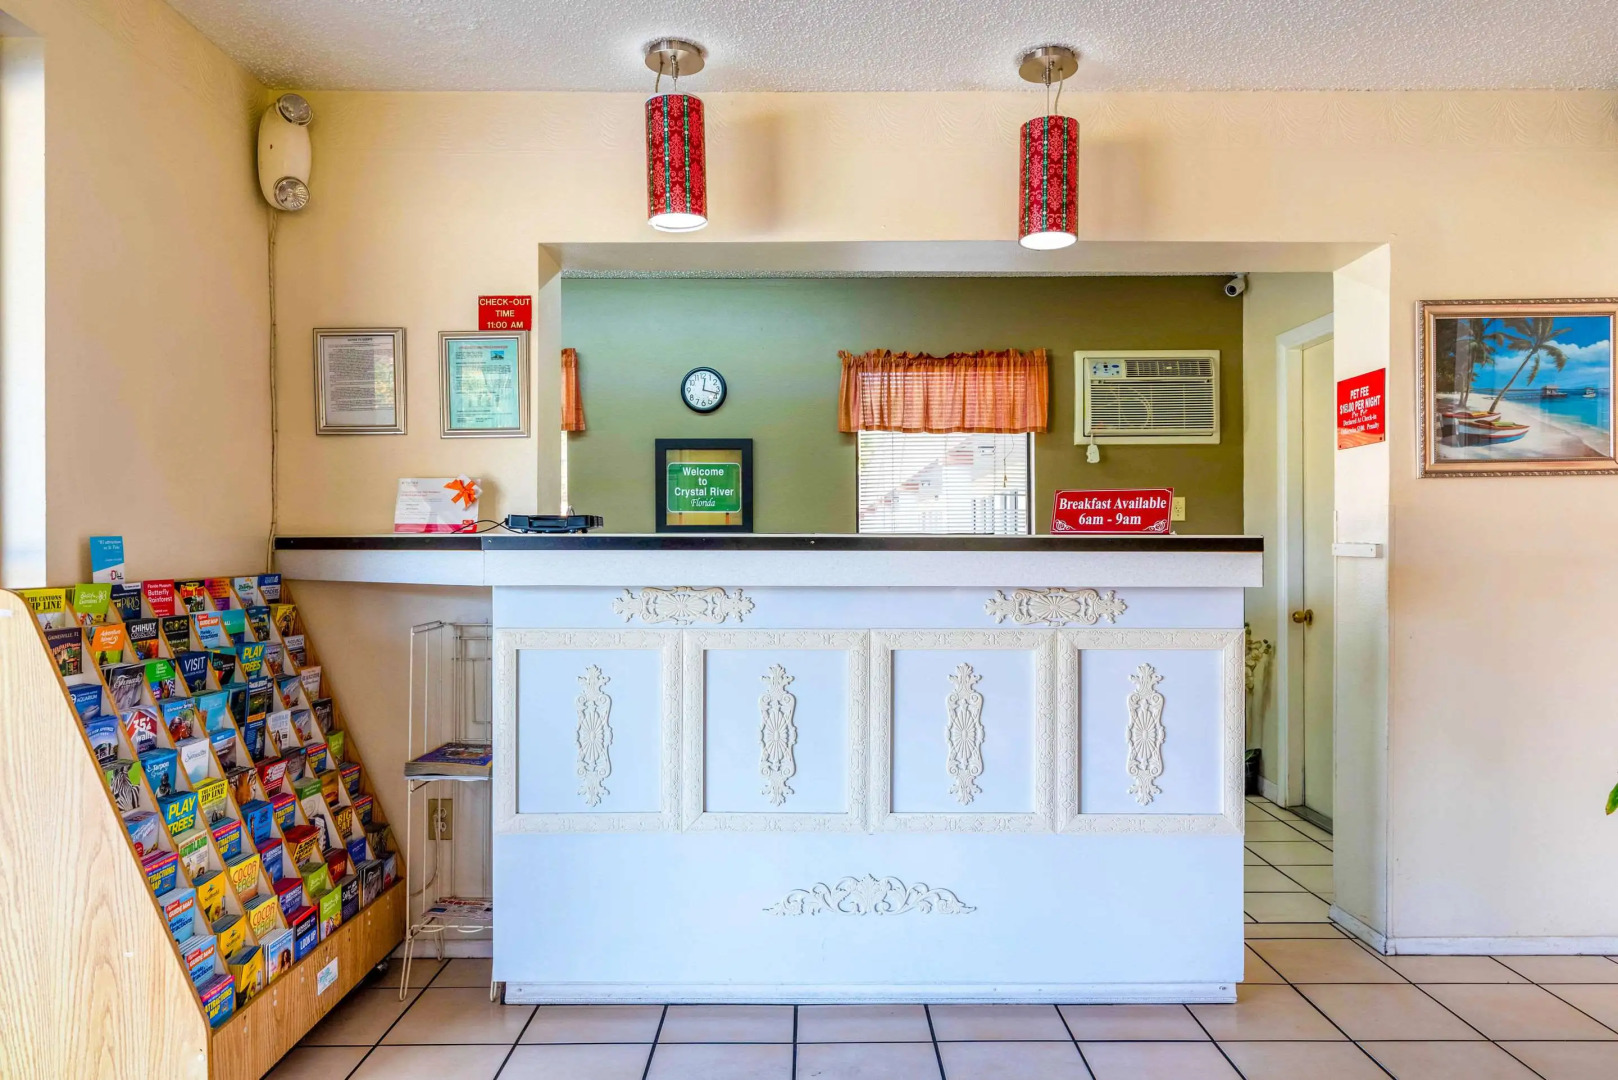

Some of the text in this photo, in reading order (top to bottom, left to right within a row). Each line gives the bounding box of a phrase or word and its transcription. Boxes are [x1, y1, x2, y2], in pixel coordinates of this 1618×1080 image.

[480, 298, 530, 306] CHECK-OUT
[1350, 386, 1369, 400] PET FEE
[1355, 399, 1364, 410] PER
[1365, 395, 1381, 408] NIGHT
[682, 467, 724, 476] Welcome
[674, 487, 734, 498] Crystal River
[690, 498, 716, 507] Florida
[1059, 497, 1167, 510] Breakfast Available
[1078, 513, 1104, 525] 6am
[1116, 513, 1141, 525] 9am
[43, 601, 61, 609] LINE
[131, 623, 156, 633] CHIHULY
[243, 645, 264, 659] PLAY
[185, 656, 206, 671] VISIT
[242, 660, 261, 672] TREES
[136, 733, 153, 742] walls
[201, 788, 224, 802] ZIP LINE
[168, 796, 196, 819] PLAY
[338, 809, 351, 825] BIG
[168, 815, 194, 833] TREES
[340, 820, 350, 831] AT
[233, 860, 257, 884] COCOA
[182, 899, 192, 910] MAP
[253, 902, 275, 926] COCOA
[300, 934, 310, 950] LOOK
[311, 930, 316, 942] UP
[204, 947, 213, 957] MAP
[210, 1005, 220, 1019] MAP
